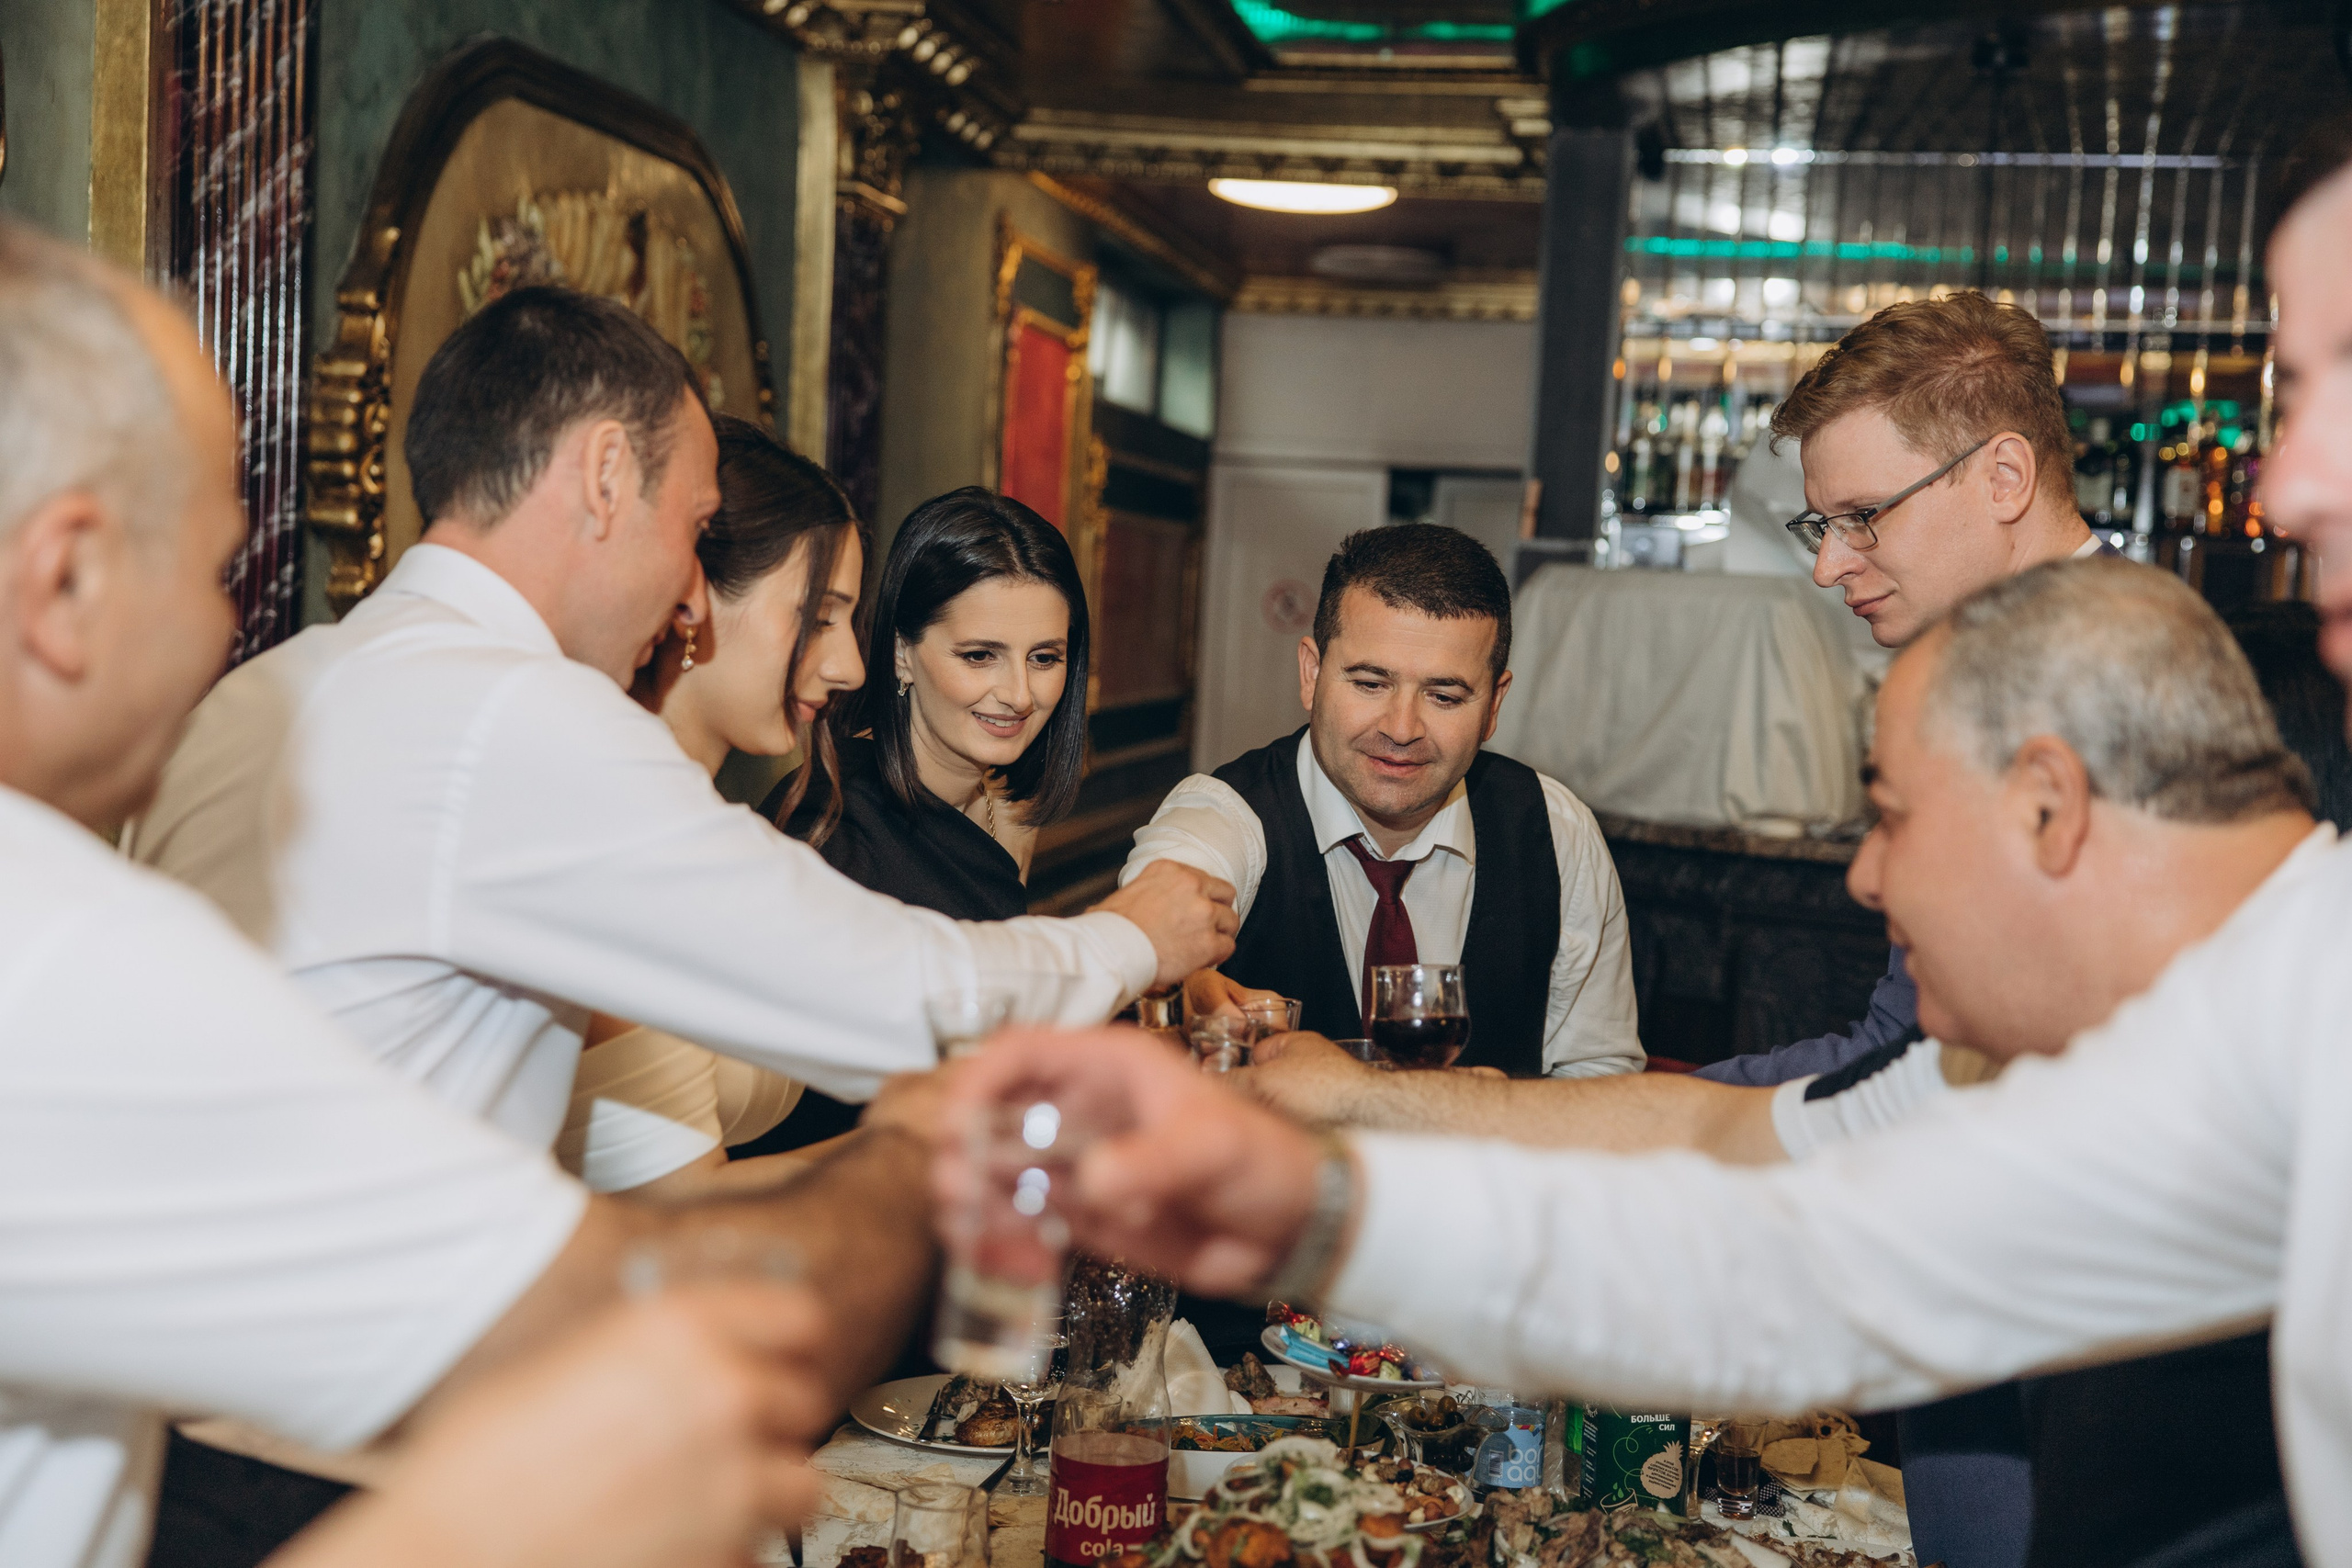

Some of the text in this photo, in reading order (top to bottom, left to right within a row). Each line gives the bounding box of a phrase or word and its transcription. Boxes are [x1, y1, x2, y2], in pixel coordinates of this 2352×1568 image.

[1631, 1414, 1670, 1424] БОЛЬШЕ
[1054, 1486, 1156, 1535] Добрый
[1080, 1539, 1124, 1558] cola
